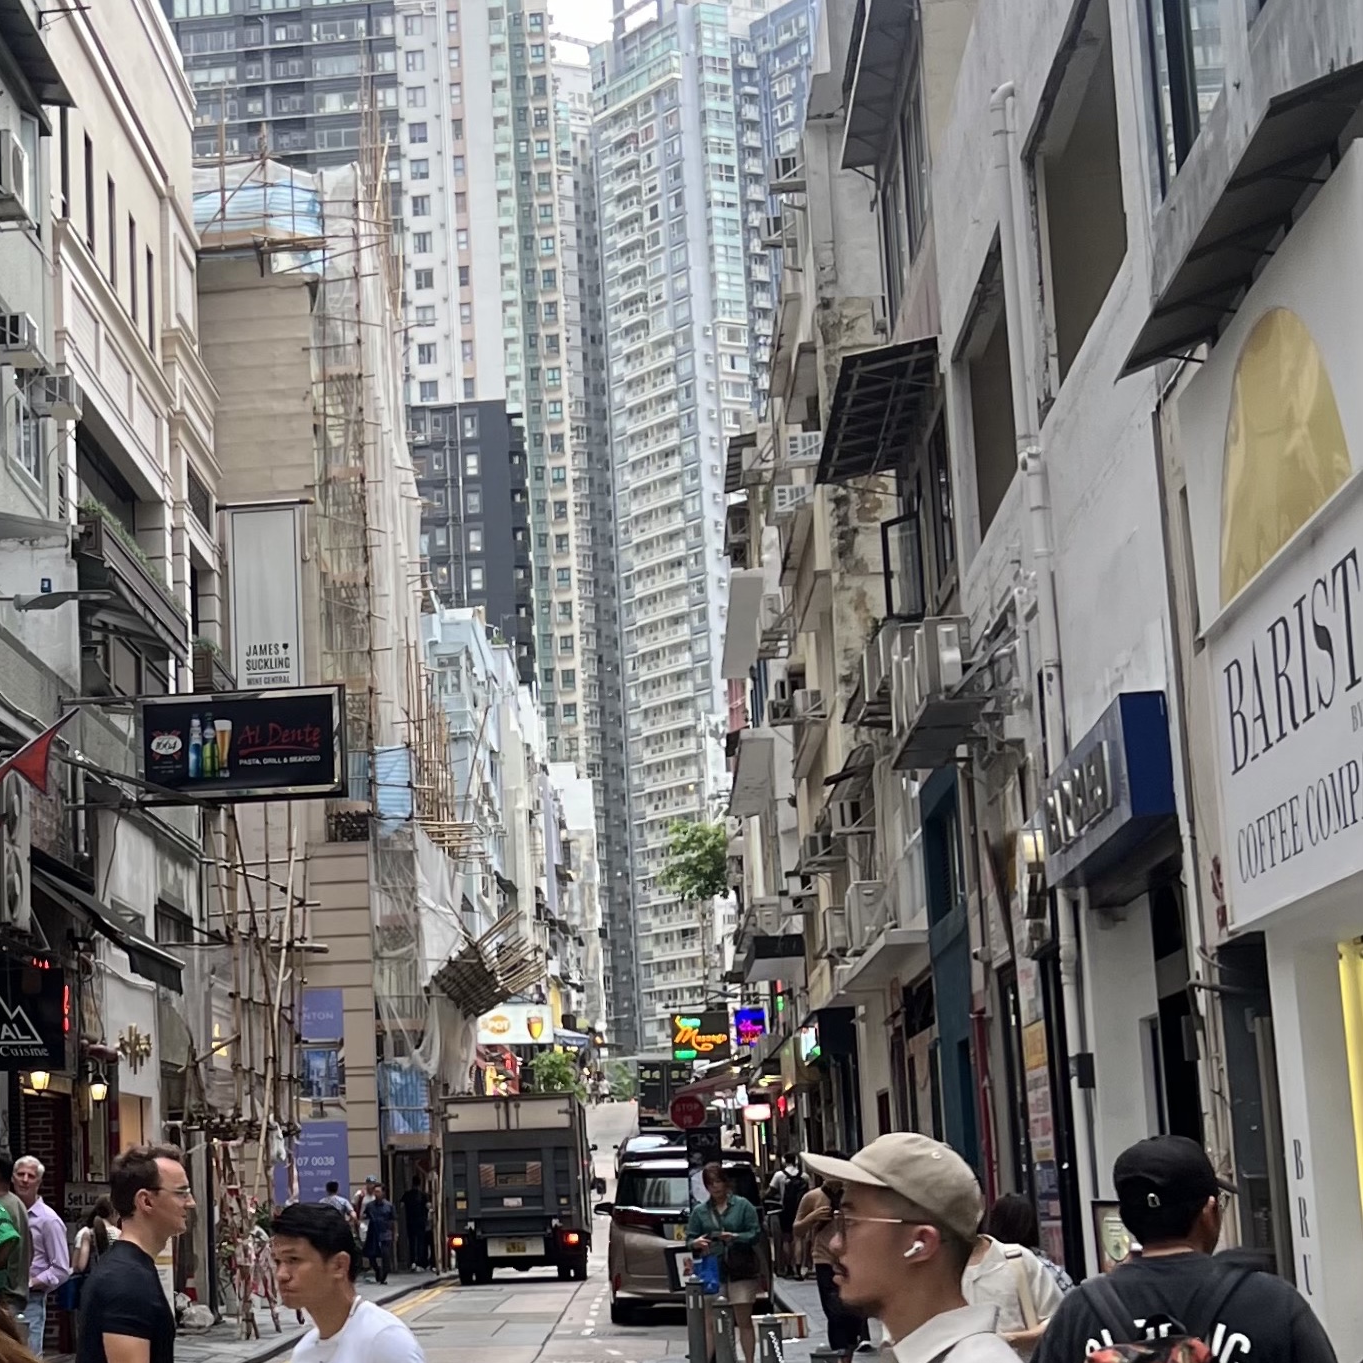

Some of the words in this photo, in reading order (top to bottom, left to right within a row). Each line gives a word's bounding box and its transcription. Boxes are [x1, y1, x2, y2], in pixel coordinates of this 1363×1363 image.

[246, 643, 280, 657] JAMES
[246, 657, 290, 671] SUCKLING
[263, 675, 290, 685] CENTRAL
[237, 725, 260, 745] Al
[268, 722, 321, 746] Dente
[239, 758, 262, 766] PASTA,
[289, 755, 321, 763] SEAFOOD
[1237, 794, 1304, 884] COFFEE
[1306, 754, 1363, 848] COMP
[0, 1044, 50, 1057] Cuisine
